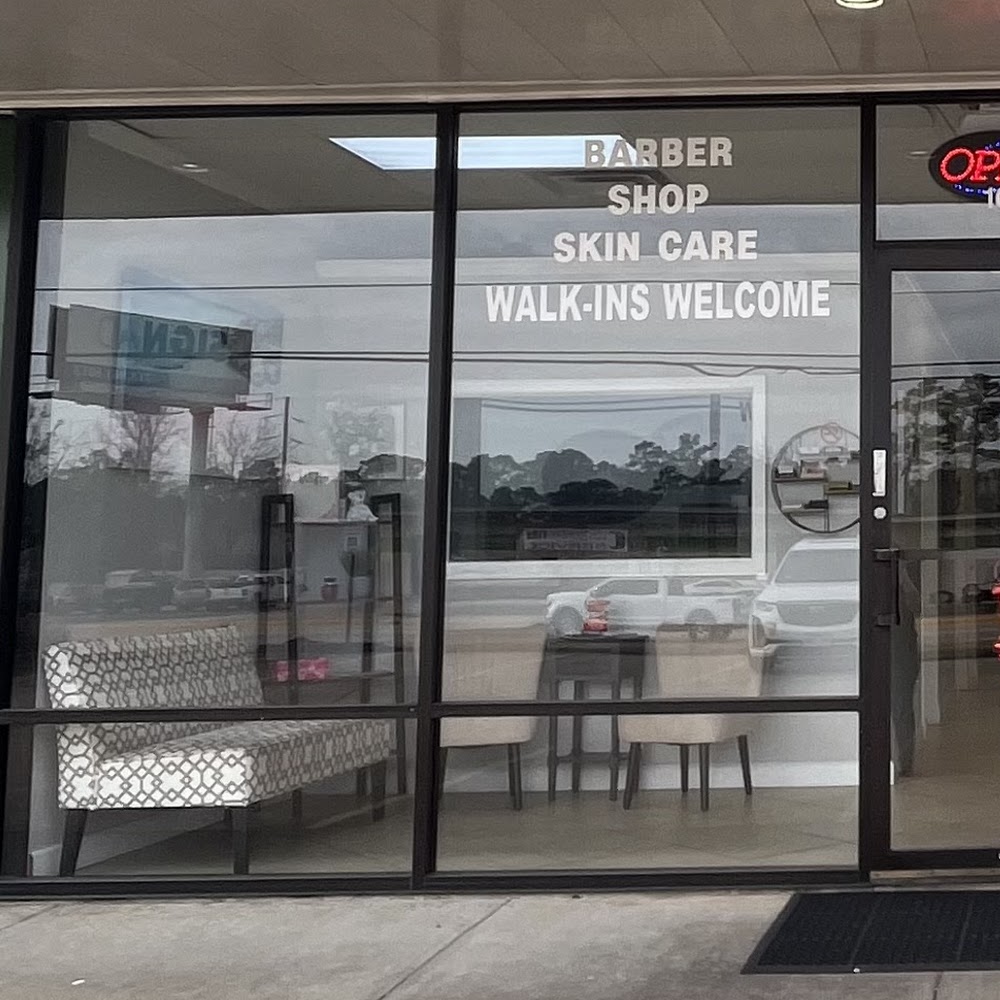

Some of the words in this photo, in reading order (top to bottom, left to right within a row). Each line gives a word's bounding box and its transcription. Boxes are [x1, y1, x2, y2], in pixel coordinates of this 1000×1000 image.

[584, 136, 734, 169] BARBER
[608, 183, 709, 216] SHOP
[553, 230, 640, 263] SKIN
[658, 229, 758, 262] CARE
[485, 282, 650, 323] WALK-INS
[662, 279, 831, 321] WELCOME
